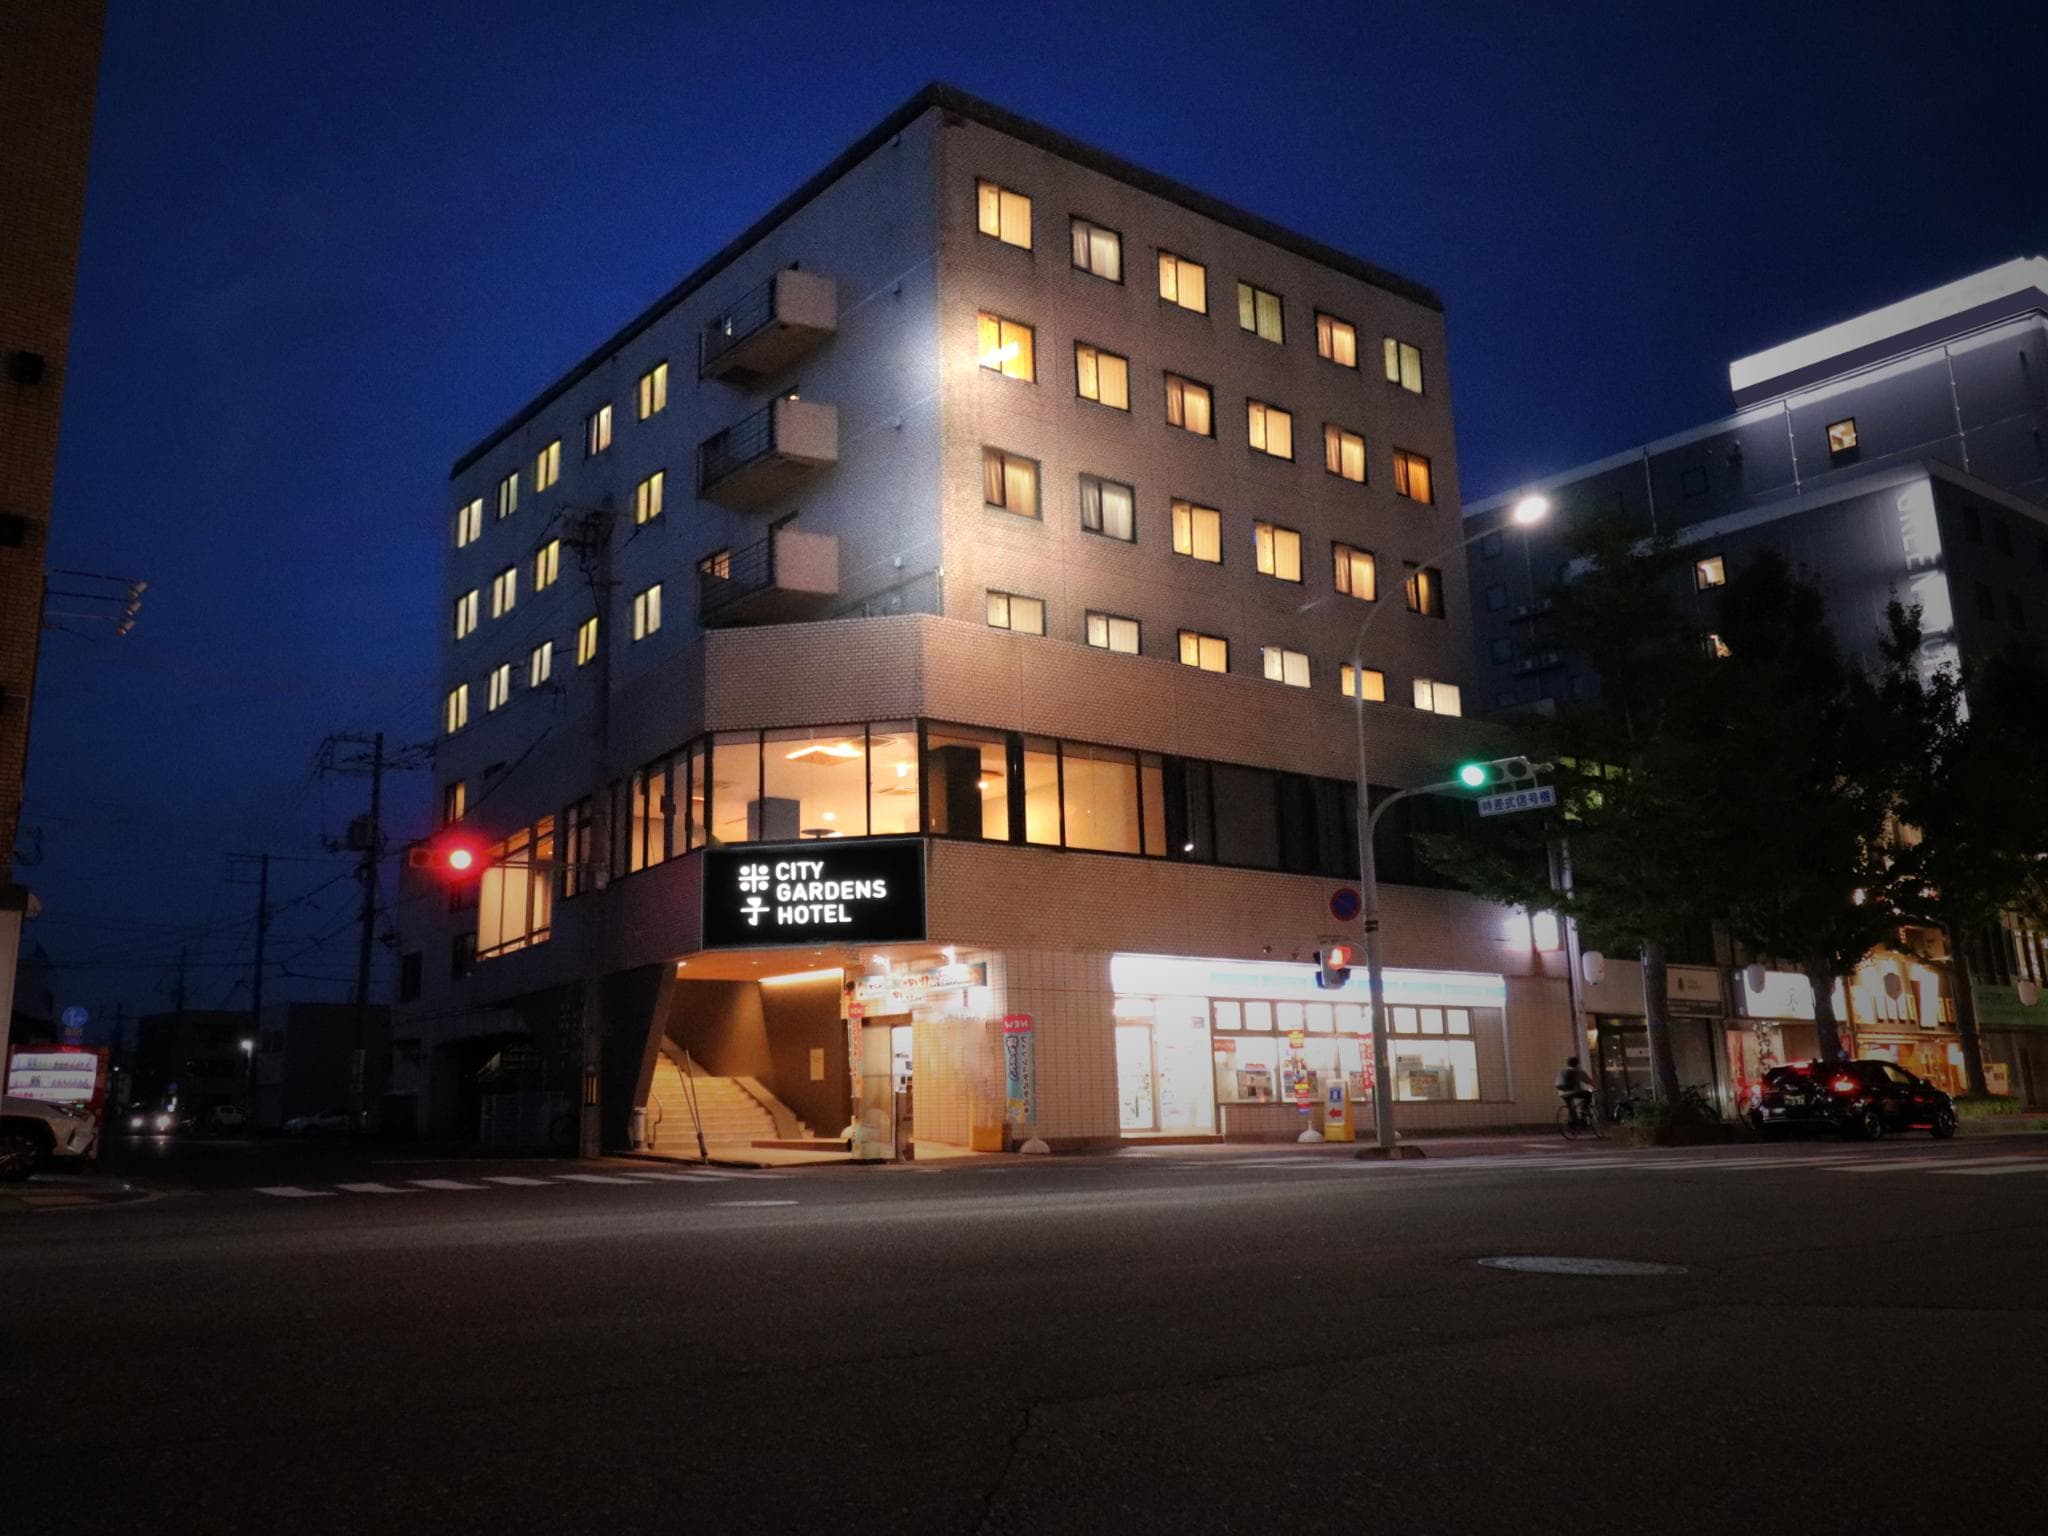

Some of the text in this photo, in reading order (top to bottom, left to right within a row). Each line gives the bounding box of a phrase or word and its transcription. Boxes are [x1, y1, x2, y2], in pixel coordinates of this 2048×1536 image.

[775, 861, 824, 881] CITY
[776, 880, 887, 902] GARDENS
[777, 904, 852, 925] HOTEL
